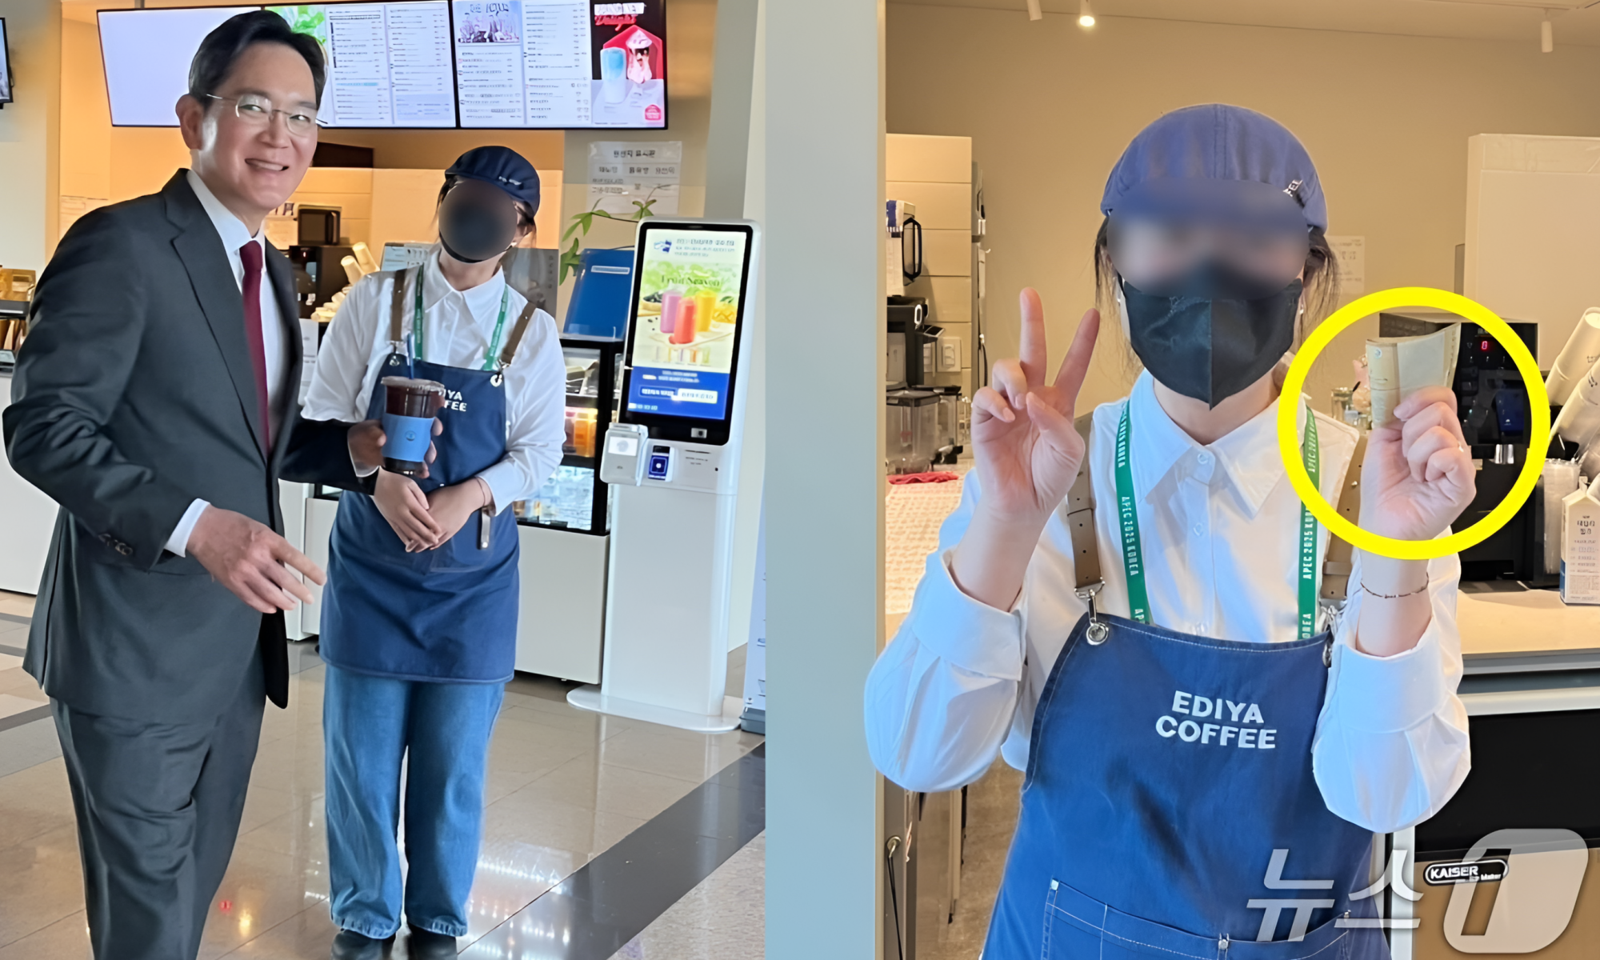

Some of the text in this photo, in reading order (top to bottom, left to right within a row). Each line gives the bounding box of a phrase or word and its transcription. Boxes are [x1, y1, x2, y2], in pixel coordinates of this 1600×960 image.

[442, 389, 462, 401] IYA
[444, 400, 467, 412] FEE
[1121, 496, 1138, 576] APEC 2025 KOREA
[1303, 531, 1313, 554] 2025
[1303, 559, 1313, 580] APEC
[1302, 613, 1312, 639] OREA
[1171, 690, 1264, 724] EDIYA
[1155, 715, 1277, 749] COFFEE
[1430, 865, 1479, 880] KAISER
